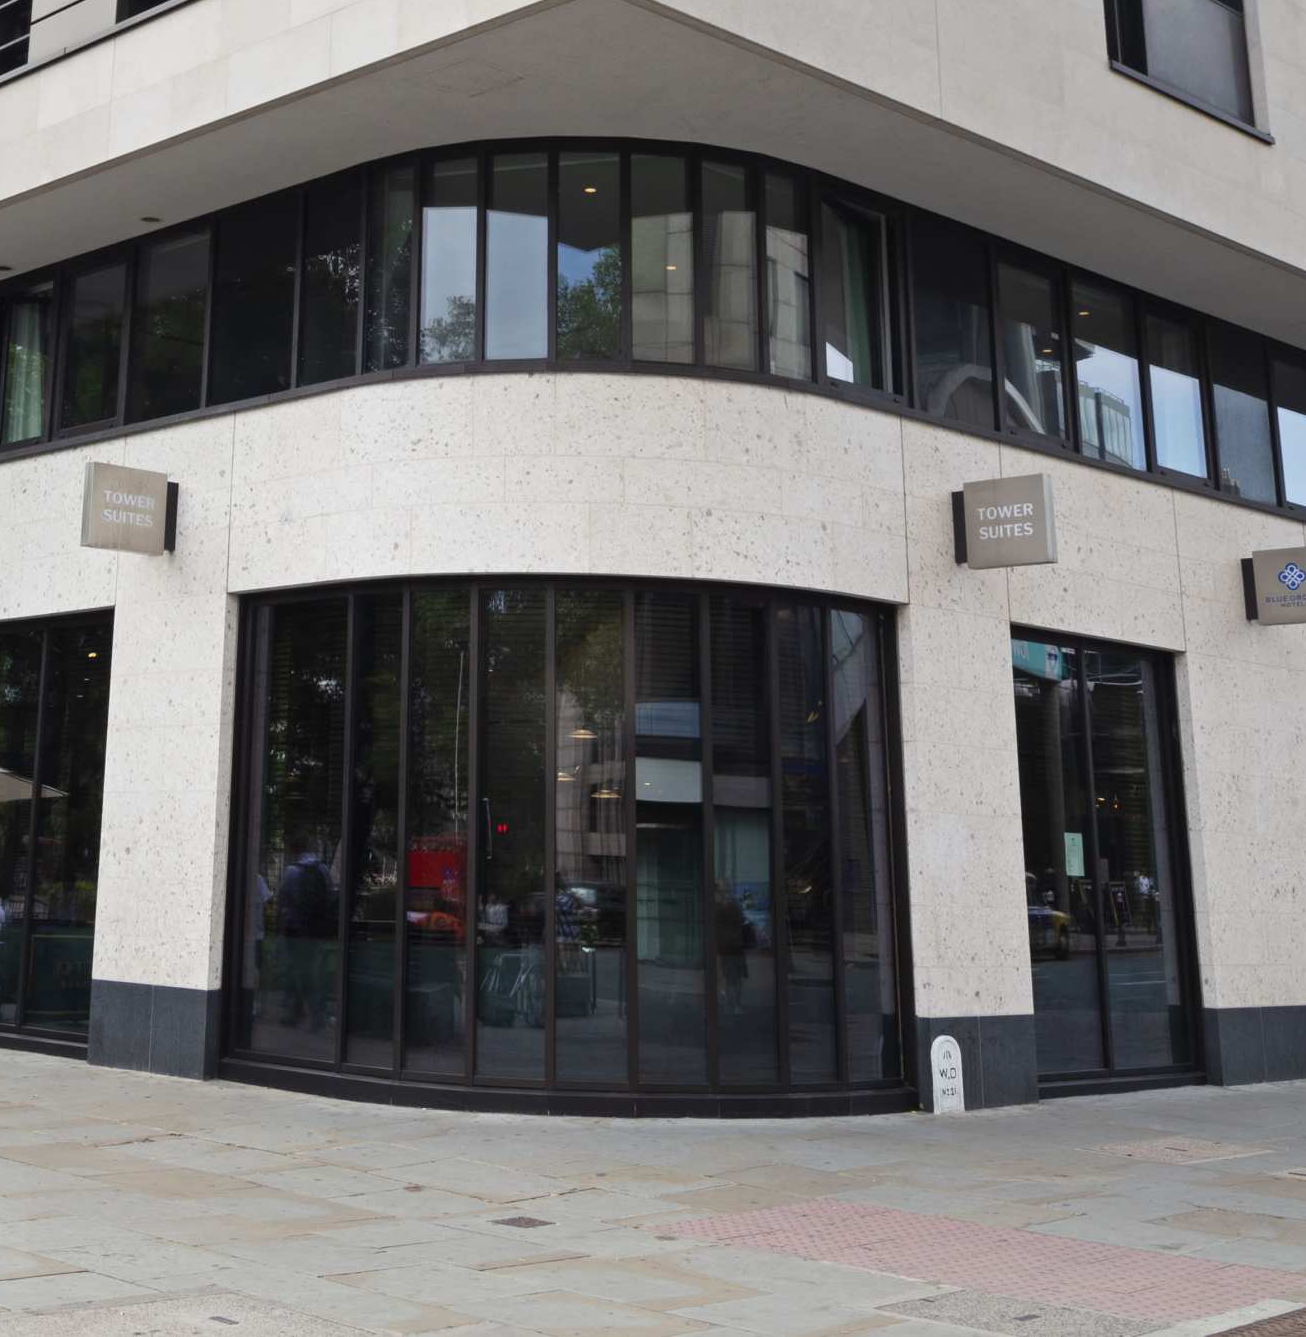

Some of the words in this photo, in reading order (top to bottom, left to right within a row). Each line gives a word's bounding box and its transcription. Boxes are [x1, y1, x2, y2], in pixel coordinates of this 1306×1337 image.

[102, 489, 156, 510] TOWER
[102, 509, 153, 527] SUITES
[977, 503, 1034, 521] TOWER
[979, 522, 1034, 540] SUITES
